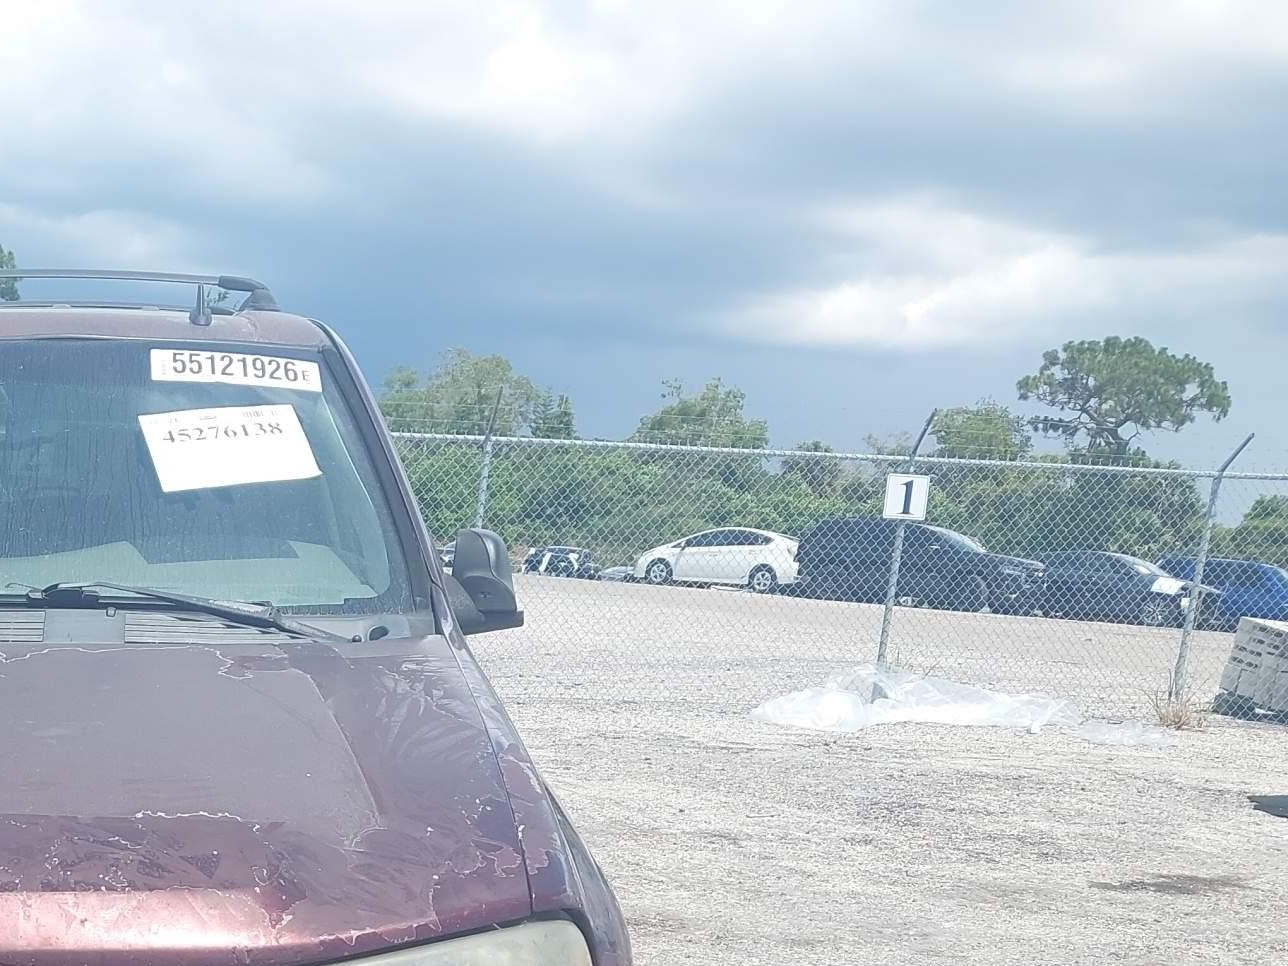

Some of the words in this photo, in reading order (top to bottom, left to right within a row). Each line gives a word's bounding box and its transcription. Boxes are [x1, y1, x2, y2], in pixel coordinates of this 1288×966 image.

[172, 352, 298, 383] 55121926
[162, 422, 284, 444] 45276138
[896, 479, 915, 516] 1
